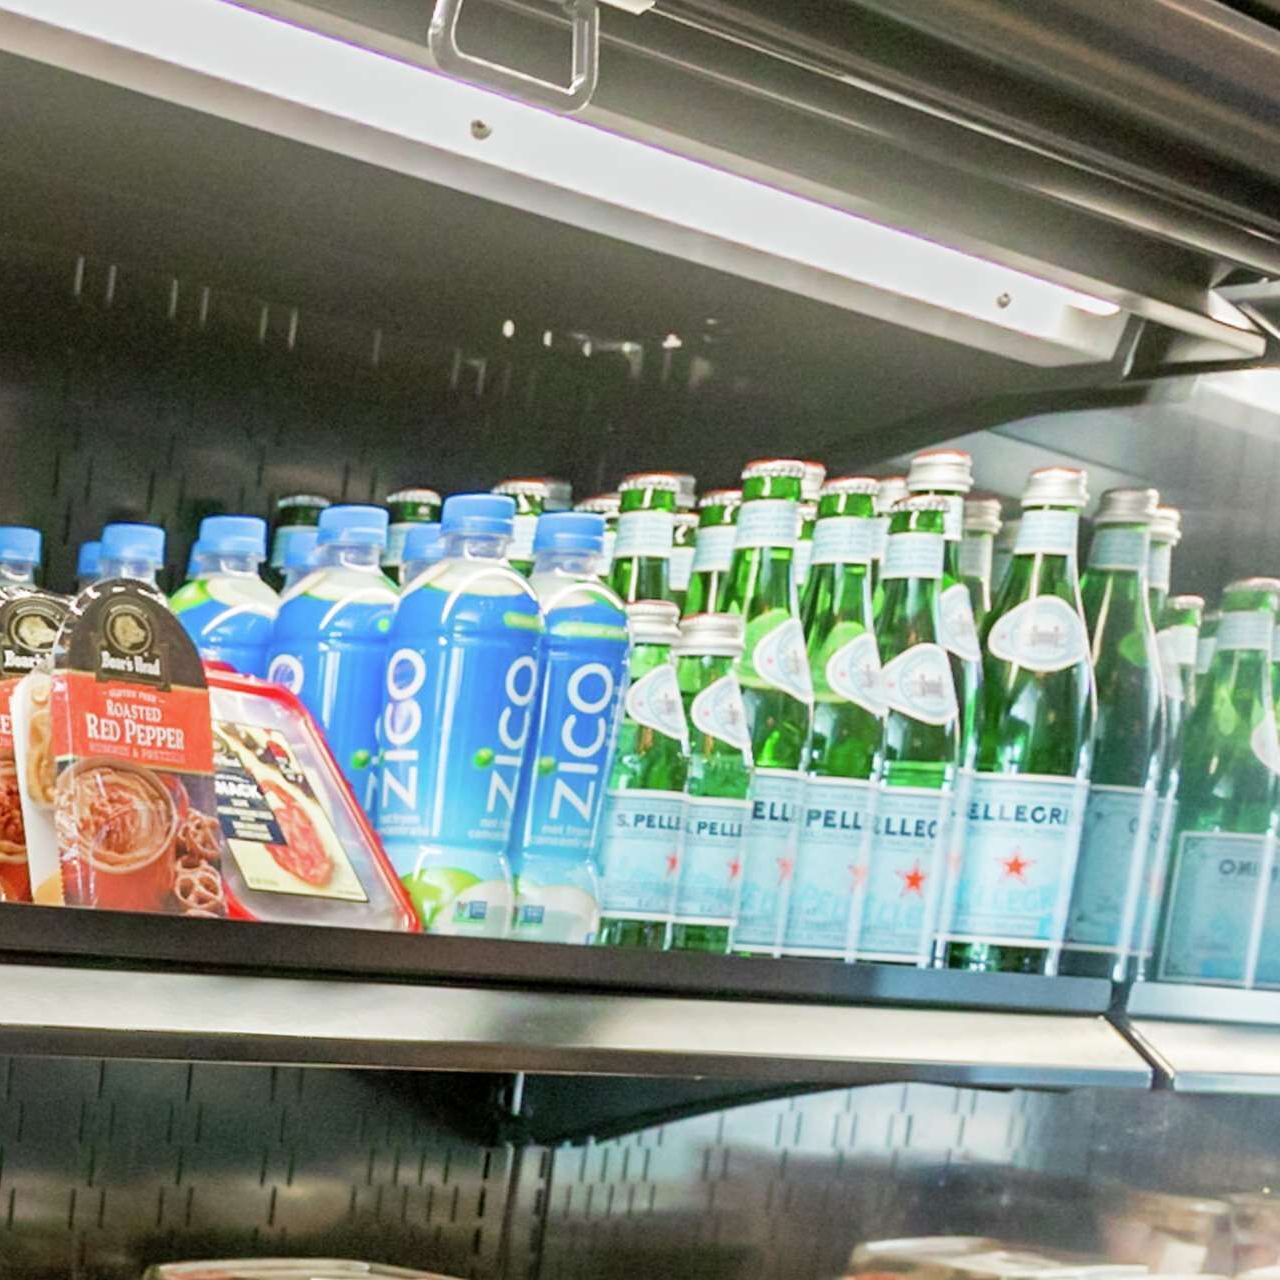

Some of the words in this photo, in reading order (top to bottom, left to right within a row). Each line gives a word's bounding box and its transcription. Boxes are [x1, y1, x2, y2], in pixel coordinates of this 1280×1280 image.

[106, 699, 162, 722] ROASTED
[85, 713, 121, 742] RED
[125, 720, 185, 750] PEPPER
[549, 662, 614, 822] ZICO
